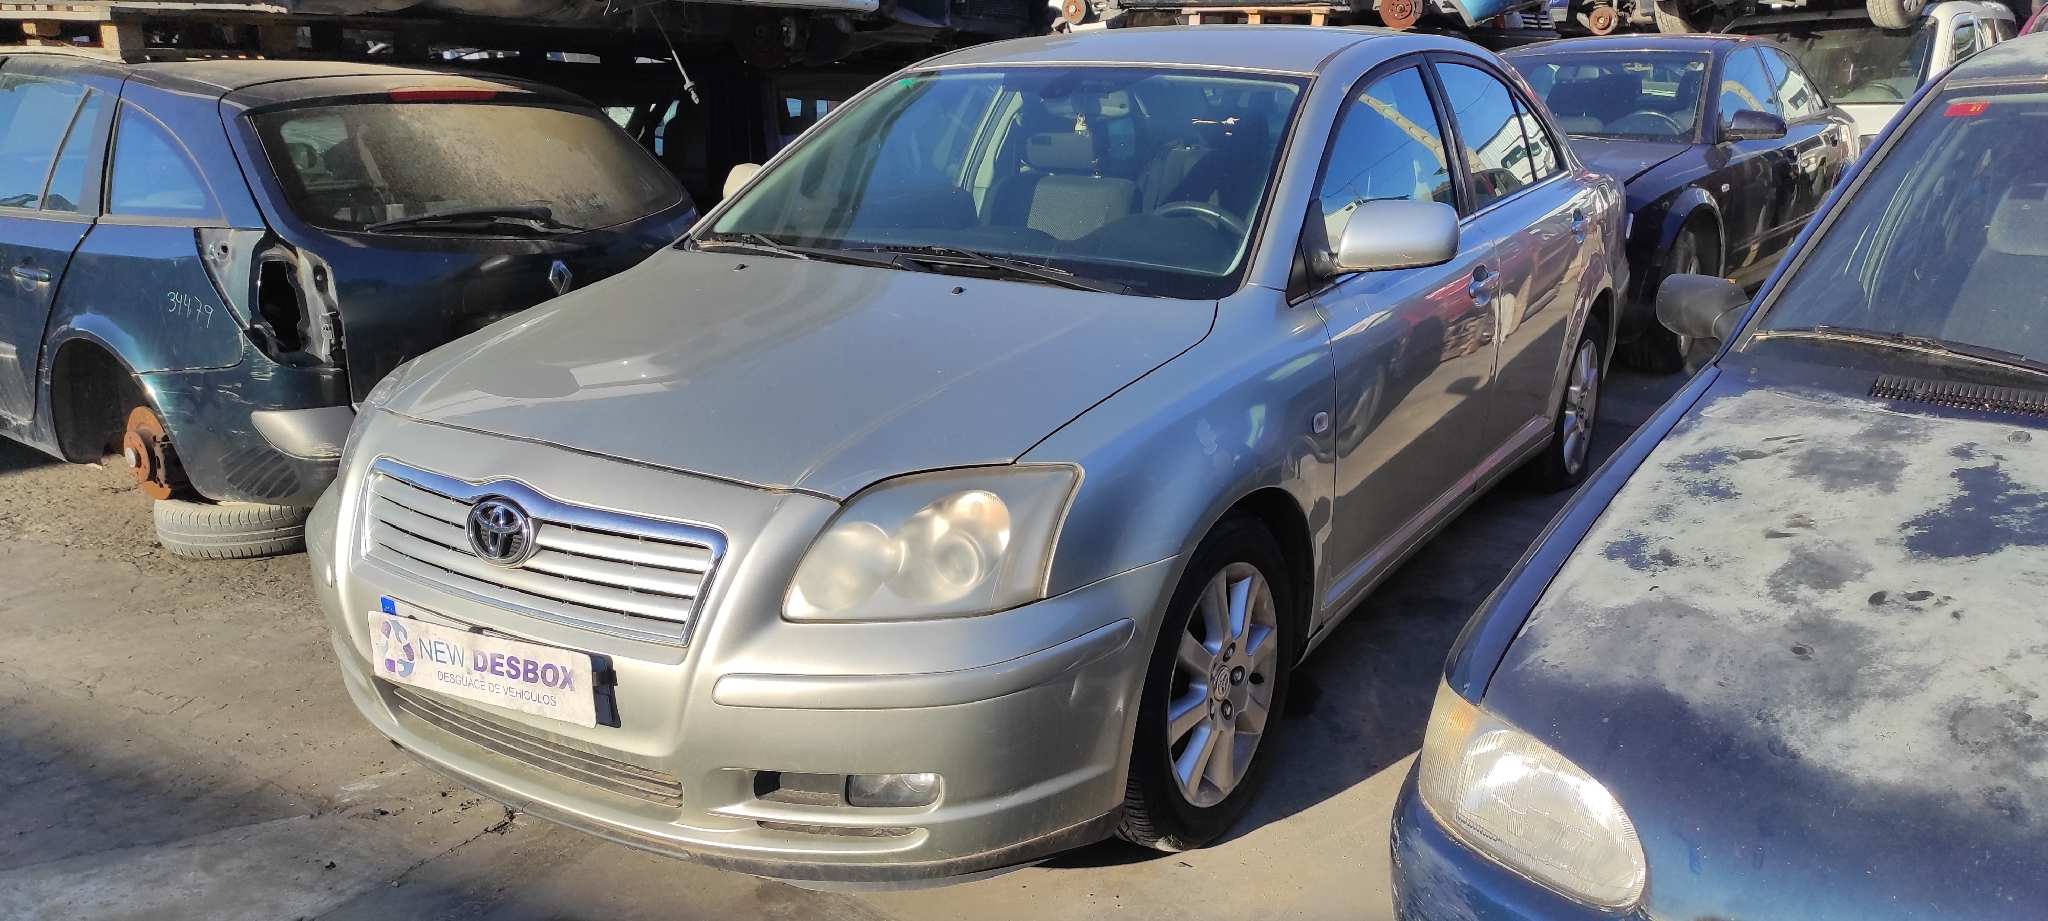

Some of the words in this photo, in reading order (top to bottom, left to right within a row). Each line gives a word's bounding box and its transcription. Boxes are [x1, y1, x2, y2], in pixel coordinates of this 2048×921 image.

[167, 291, 214, 328] 34479
[418, 637, 465, 668] NEW
[473, 650, 576, 692] DESBOX
[437, 670, 486, 691] DESGUACE
[488, 682, 502, 694] DE
